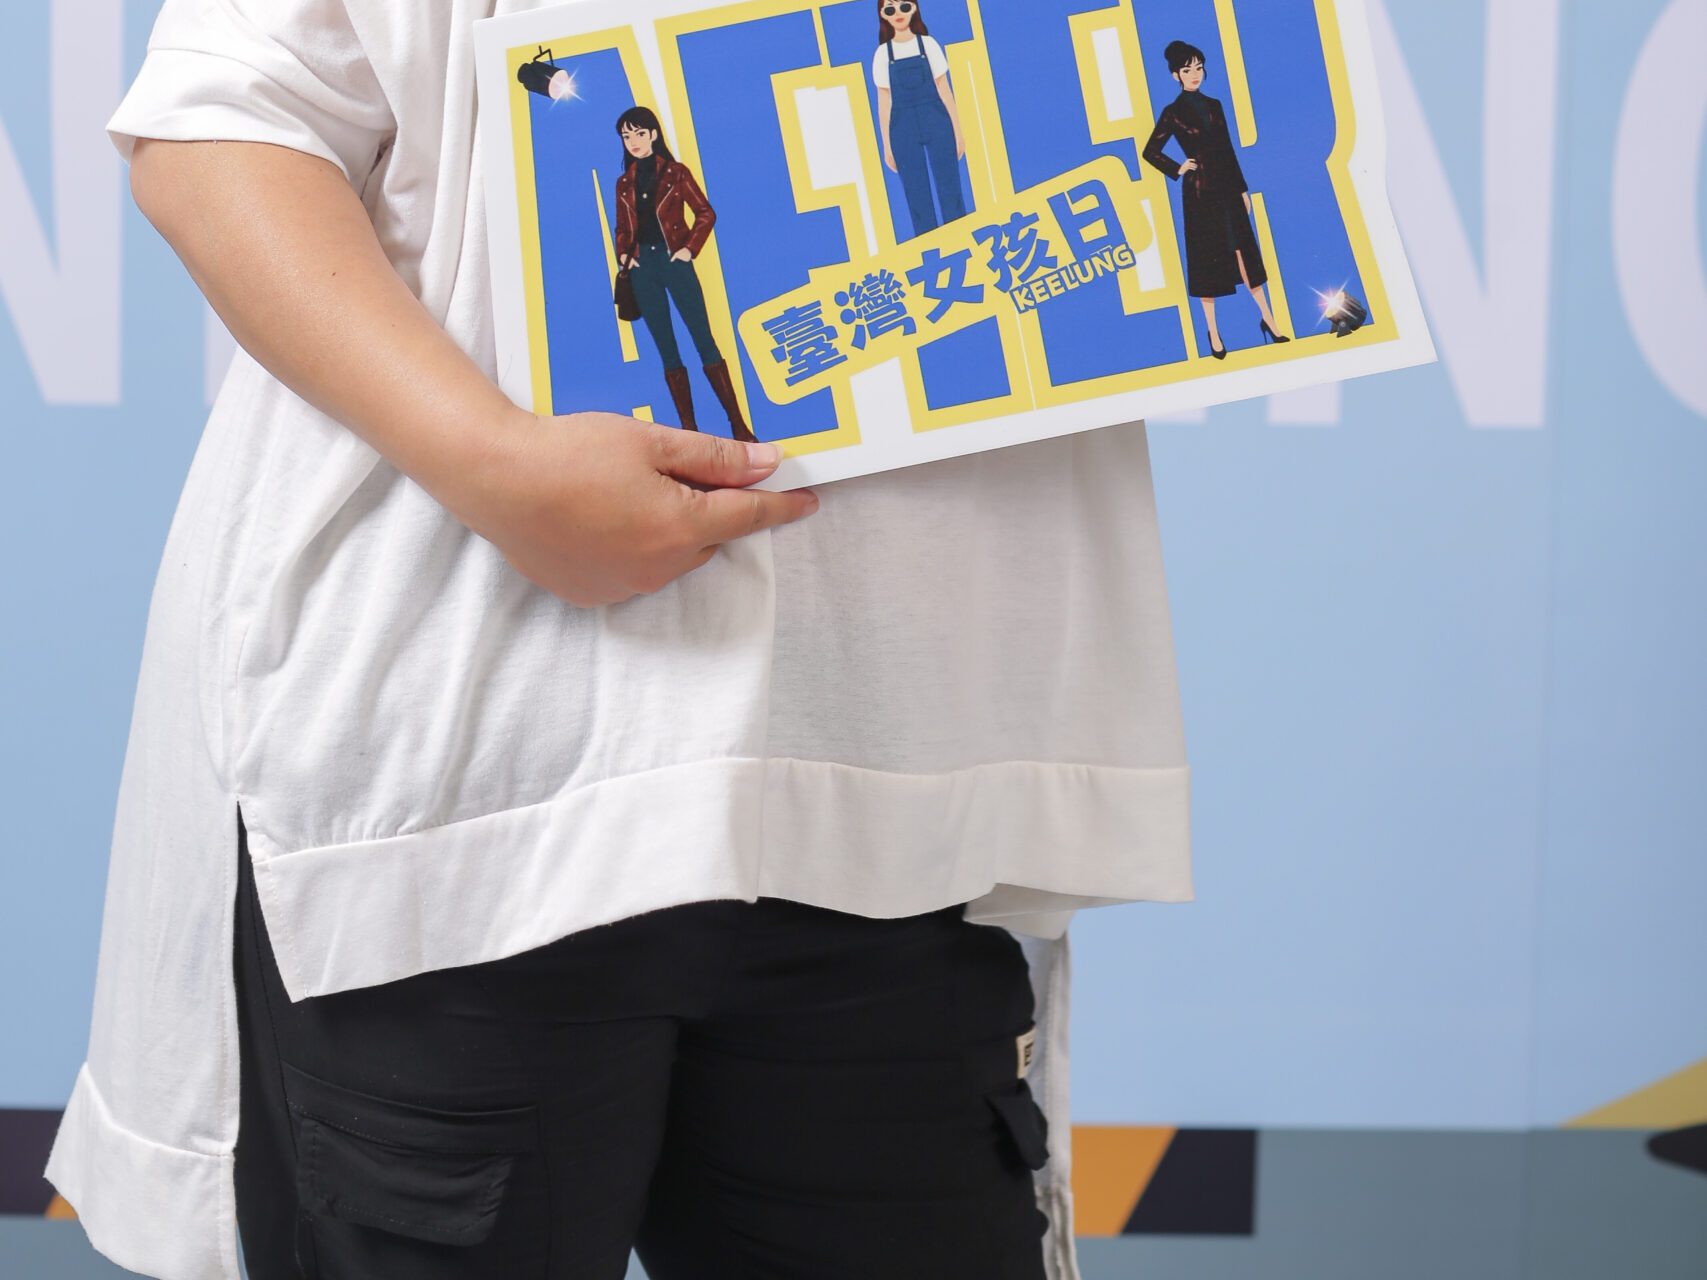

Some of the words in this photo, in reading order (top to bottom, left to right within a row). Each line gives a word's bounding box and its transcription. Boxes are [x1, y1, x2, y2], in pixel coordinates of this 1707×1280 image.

[761, 179, 1129, 388] 臺灣女孩日
[1011, 242, 1137, 314] KEELUNG
